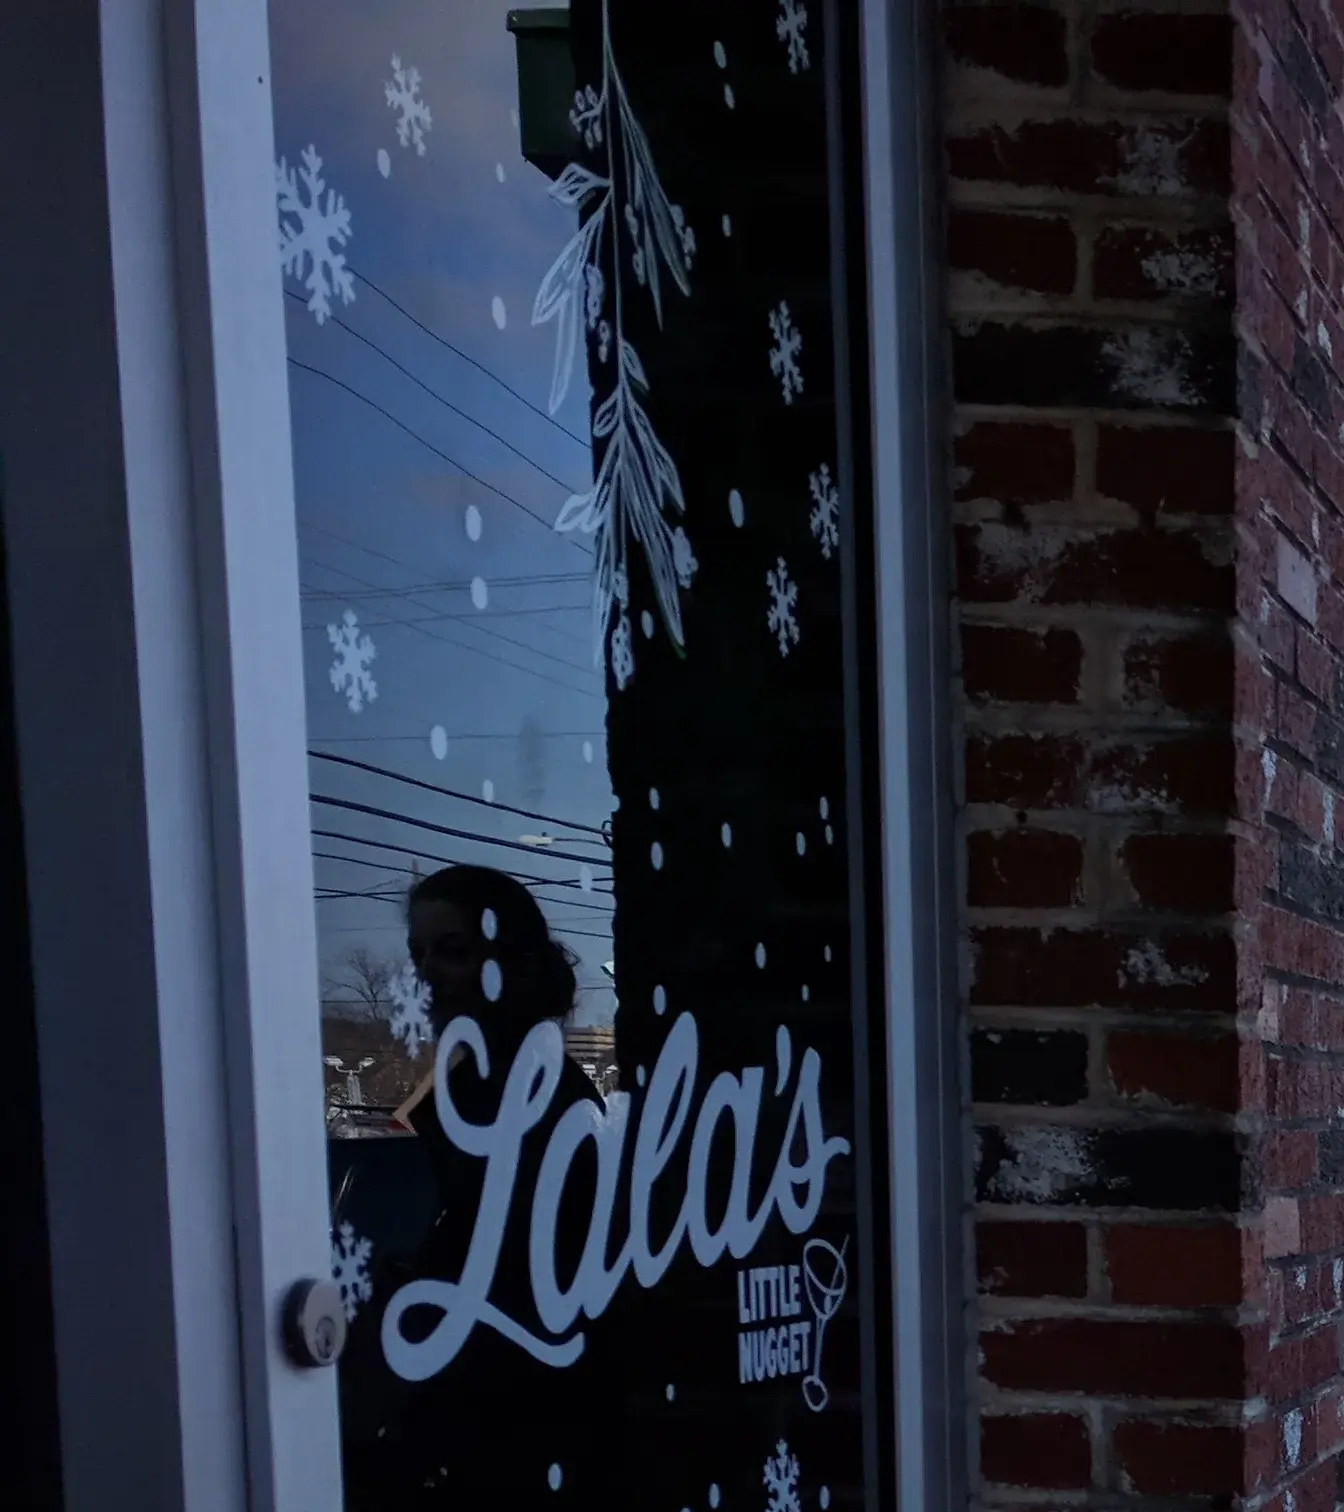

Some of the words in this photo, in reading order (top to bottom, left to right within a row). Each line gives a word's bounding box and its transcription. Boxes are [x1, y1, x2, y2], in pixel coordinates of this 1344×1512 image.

[381, 1011, 851, 1382] Lala's
[738, 1264, 801, 1324] LITTLE
[738, 1321, 811, 1384] NUGGET
